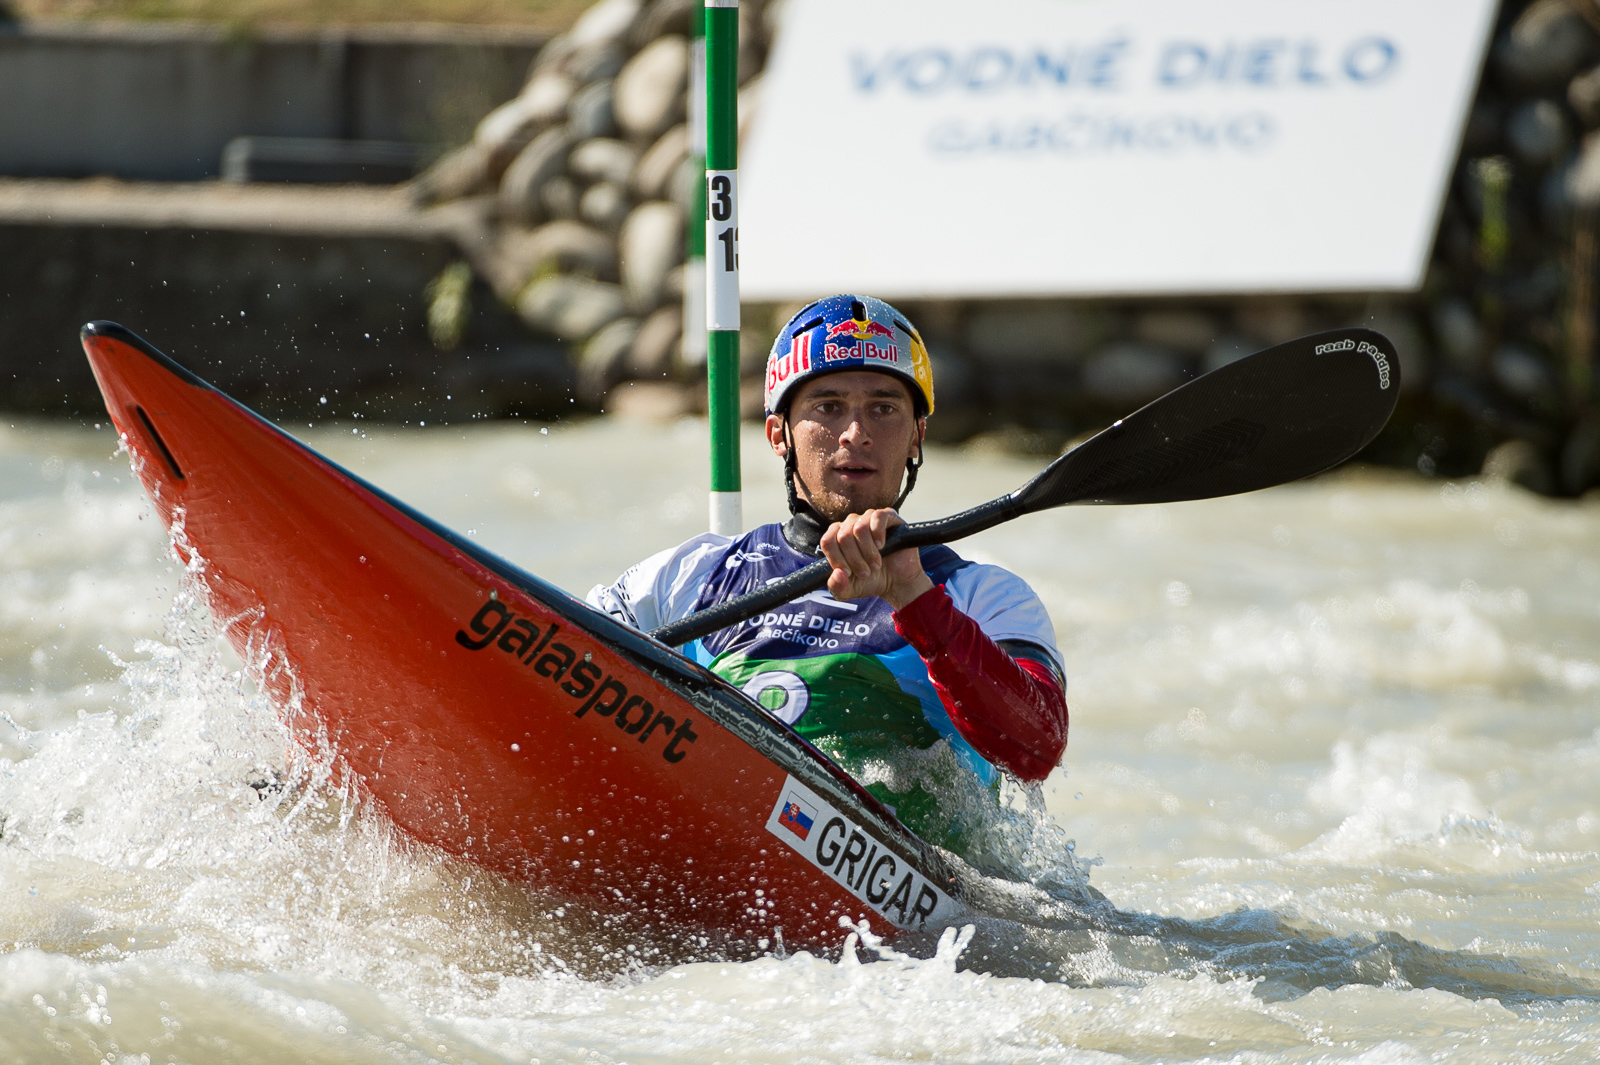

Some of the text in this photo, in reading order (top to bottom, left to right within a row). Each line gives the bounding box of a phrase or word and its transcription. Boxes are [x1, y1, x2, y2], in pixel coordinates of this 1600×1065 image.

[848, 35, 1400, 92] VODNÉ DIELO
[768, 334, 810, 394] Bull
[825, 340, 898, 363] Red Bull
[1315, 339, 1390, 389] raab paddles
[756, 628, 839, 649] ABČÍKOVO
[808, 615, 870, 637] DIELO
[455, 598, 698, 764] galasport
[816, 816, 938, 931] GRIGAR
